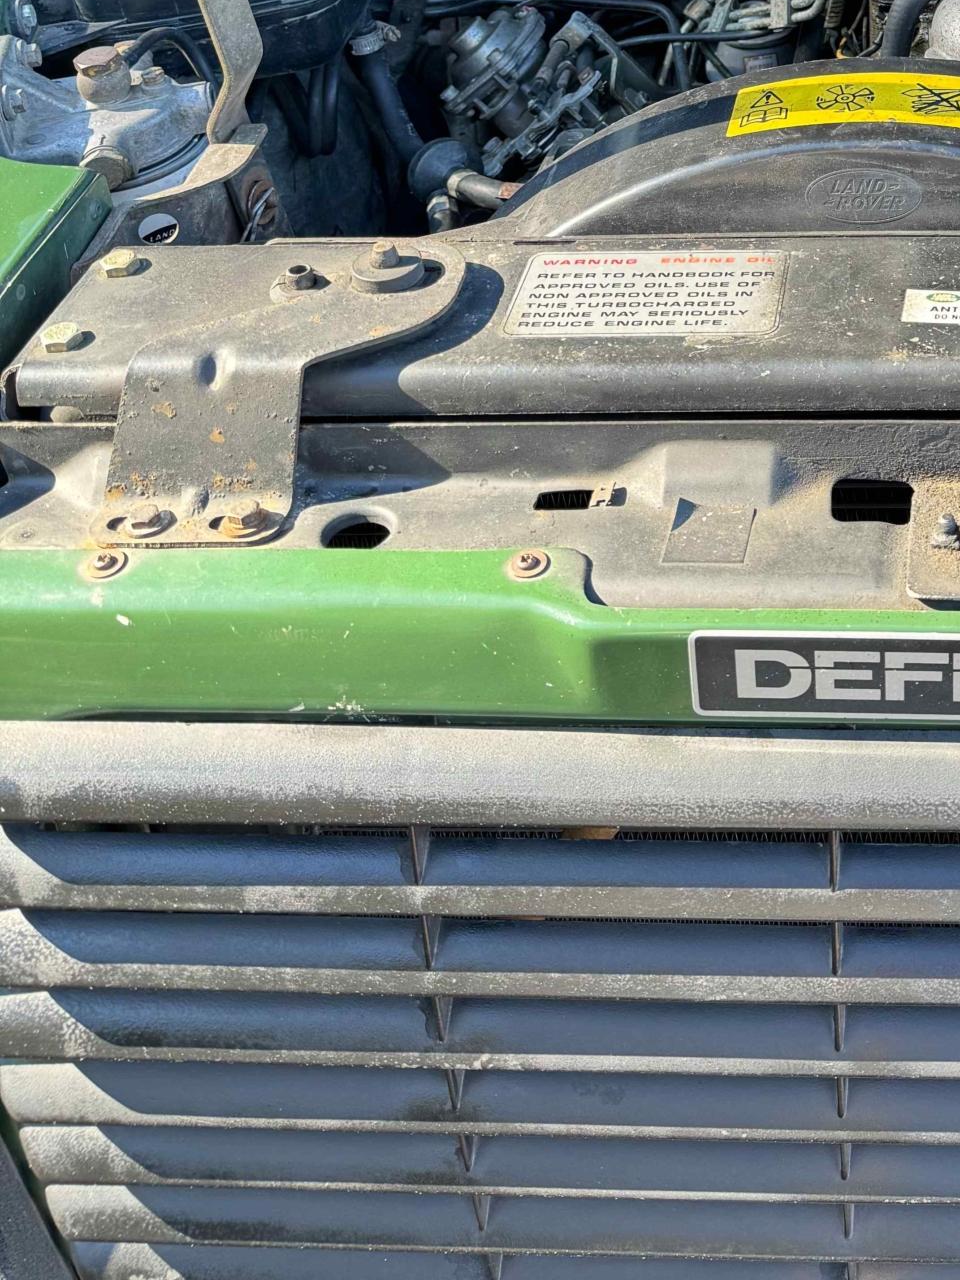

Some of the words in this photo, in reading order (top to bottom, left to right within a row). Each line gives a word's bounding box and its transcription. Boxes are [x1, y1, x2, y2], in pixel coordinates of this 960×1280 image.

[831, 178, 888, 195] LAND
[834, 195, 906, 212] ROVER
[543, 258, 638, 266] WARNING
[533, 282, 636, 290] APPROVED
[695, 281, 730, 289] USE
[575, 291, 679, 299] APPROVED
[576, 300, 736, 308] TURBOCHARGED
[600, 310, 639, 318] MAY
[648, 309, 749, 317] SERIOUSLY
[518, 320, 594, 328] REDUCE
[684, 319, 728, 327] LIFE.
